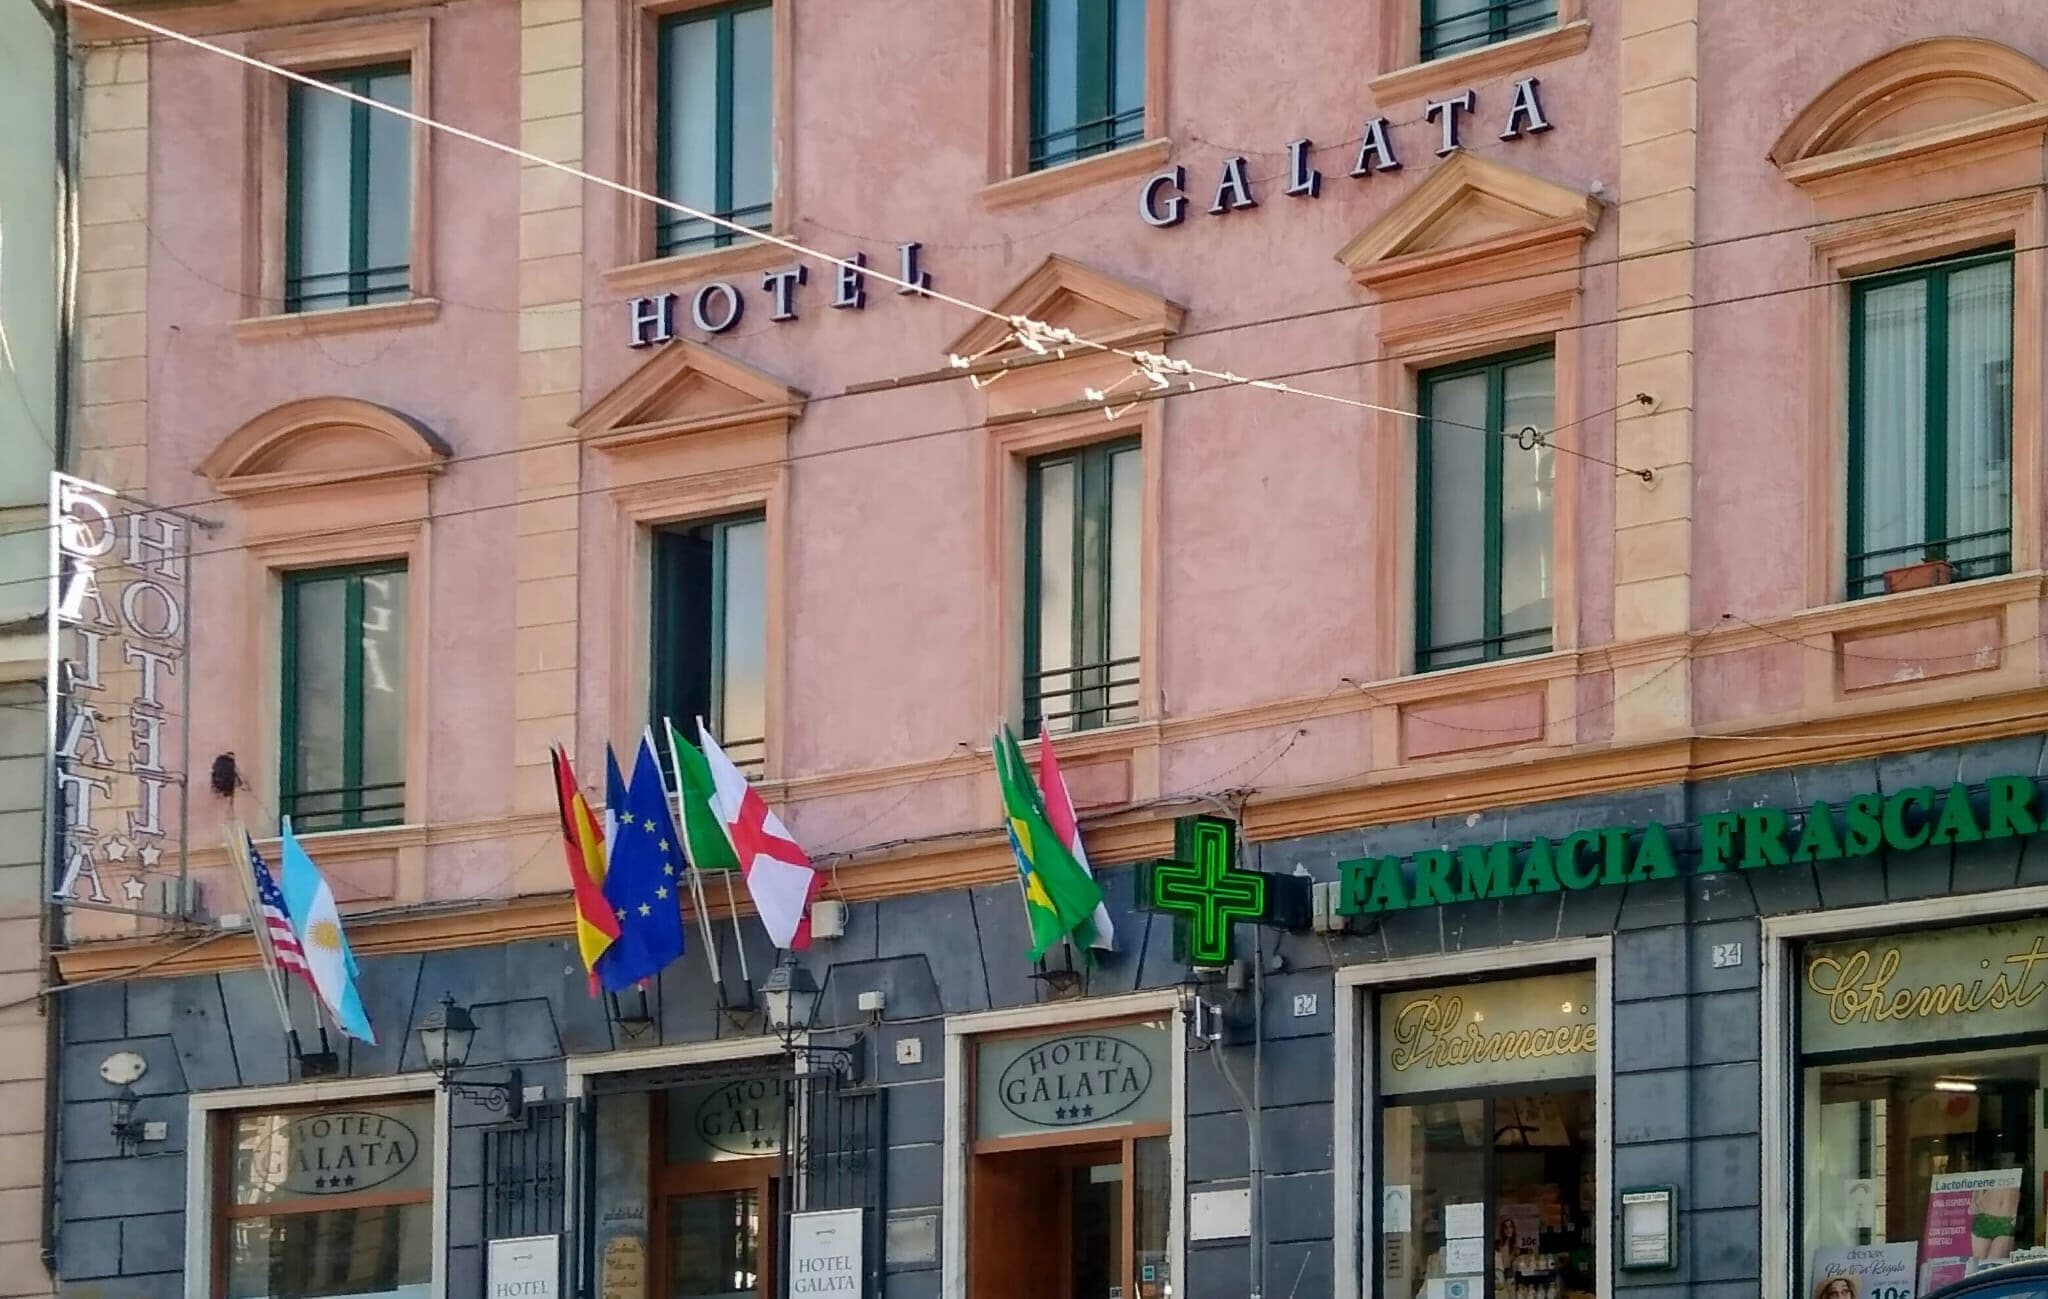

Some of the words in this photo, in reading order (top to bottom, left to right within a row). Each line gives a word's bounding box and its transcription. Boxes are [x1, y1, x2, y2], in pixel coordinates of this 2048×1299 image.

[627, 242, 933, 349] HOTEL
[1139, 77, 1553, 228] GALATA
[1335, 820, 1678, 916] FARMACIA
[1697, 774, 2048, 873] FRASCAR
[1719, 943, 1739, 966] 34
[1808, 936, 2048, 1026] Chemist
[1297, 995, 1315, 1014] 32
[1391, 995, 1598, 1072] Pharmacie
[1029, 1040, 1122, 1076] HOTEL
[1006, 1067, 1140, 1104] GALATA
[799, 1256, 851, 1273] HOTEL
[497, 1280, 549, 1297] HOTEL
[794, 1275, 856, 1293] GALATA
